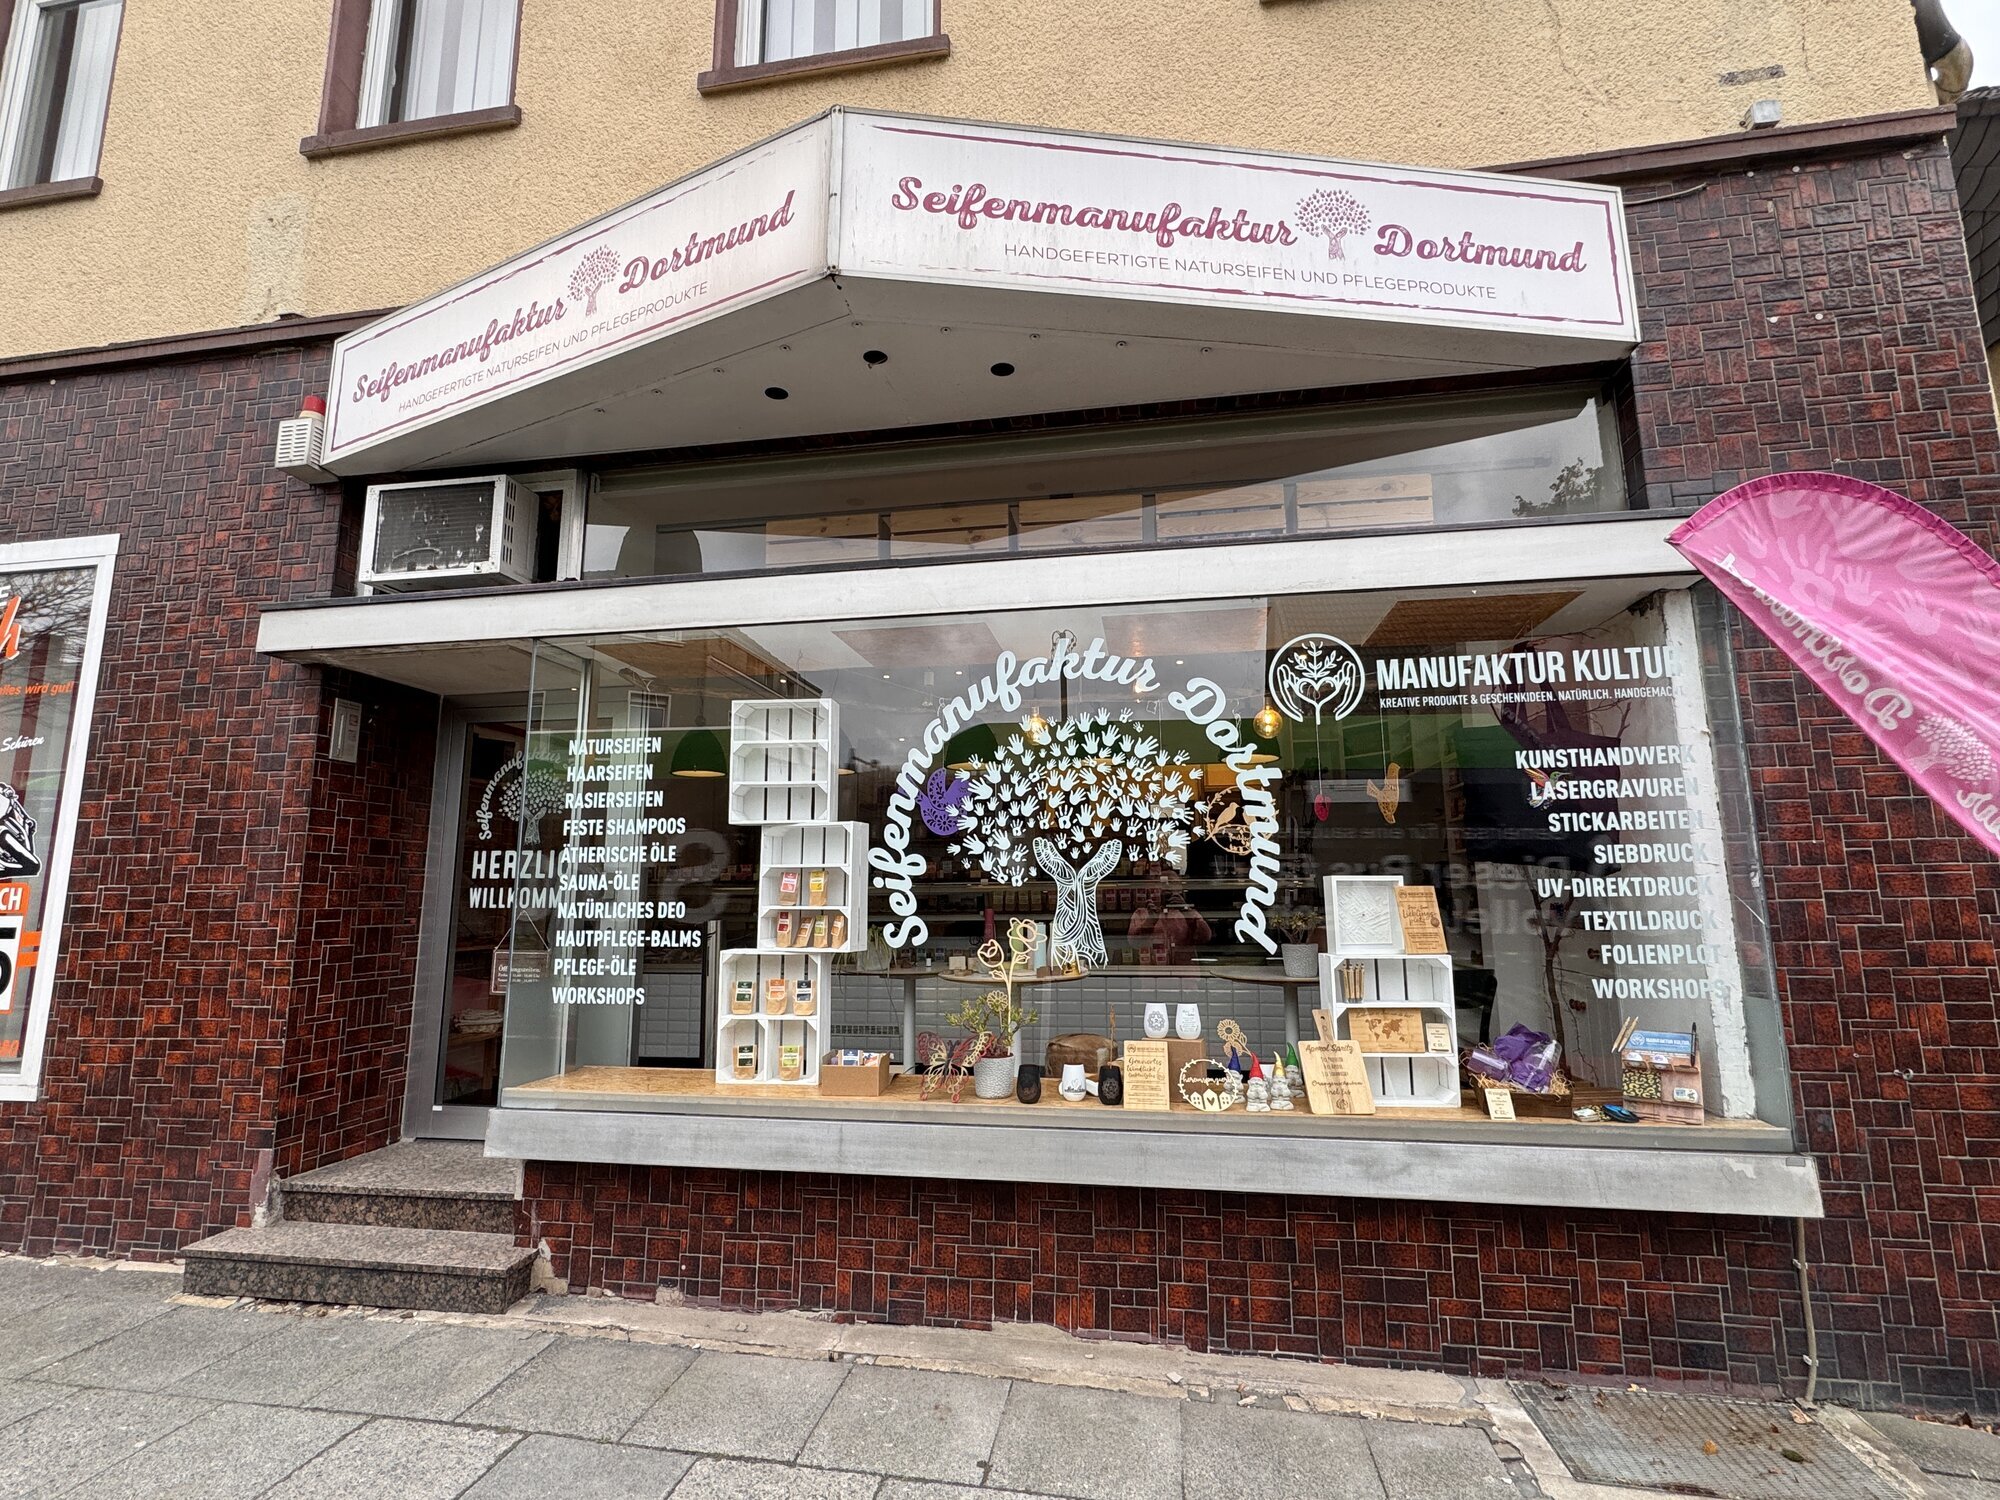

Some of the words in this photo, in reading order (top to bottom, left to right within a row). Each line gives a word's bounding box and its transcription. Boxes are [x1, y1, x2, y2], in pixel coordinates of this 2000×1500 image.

[891, 176, 1298, 248] Seifenmanufaktur
[1373, 223, 1587, 274] Dortmund
[1004, 243, 1170, 271] HANDGEFERTIGTE
[1175, 258, 1296, 281] NATURSEIFEN
[1301, 270, 1338, 285] UND
[1343, 273, 1497, 299] PFLEGEPRODUKTE
[352, 293, 568, 404] Seifenmanufaktur
[618, 190, 796, 295] Dortmund
[398, 370, 485, 413] HANDGEFERTIGTE
[486, 342, 561, 382] NATURSEIFEN
[563, 329, 589, 349] UND
[591, 281, 708, 335] PFLEGEPRODUKTE
[1376, 651, 1566, 691] MANUFAKTUR
[25, 682, 49, 695] wird
[1380, 697, 1420, 708] KREATIVE
[1422, 694, 1469, 707] PRODUKTE
[1470, 694, 1478, 705] &
[1480, 690, 1556, 704] GESCHENKIDEEN.
[1558, 687, 1613, 702] NATÜRLICH.
[0, 735, 45, 752] Schüren
[568, 737, 662, 756] NATURSEIFEN
[1515, 744, 1697, 770] KUNSTHANDWERK
[566, 763, 654, 783] HAARSEIFEN
[867, 637, 1161, 949] Seifenmanufaktur
[1168, 676, 1283, 955] Dortmund
[1530, 776, 1699, 801] LASERGRAVUREN
[564, 790, 664, 809] RASIERSEIFEN
[562, 819, 604, 837] FESTE
[606, 817, 687, 836] SHAMPOOS
[1548, 808, 1703, 833] STICKARBEITEN
[561, 843, 648, 864] ÄTHERISCHE
[650, 841, 677, 863] ÖLE
[1593, 842, 1709, 865] SIEBDRUCK
[559, 870, 640, 891] SAUNA-ÖLE
[1537, 876, 1714, 898] UV-DIREKTDRUCK
[557, 898, 655, 919] NATÜRLICHES
[657, 901, 686, 919] DEO
[1580, 910, 1719, 931] TEXTILDRUCK
[555, 930, 702, 948] HAUTPFLEGE-BALMS
[1601, 944, 1721, 965] FOLIENPLOT
[553, 955, 638, 976] PFLEGE-ÖLE
[551, 986, 646, 1006] WORKSHOPS
[1591, 978, 1727, 1000] WORKSHOPS
